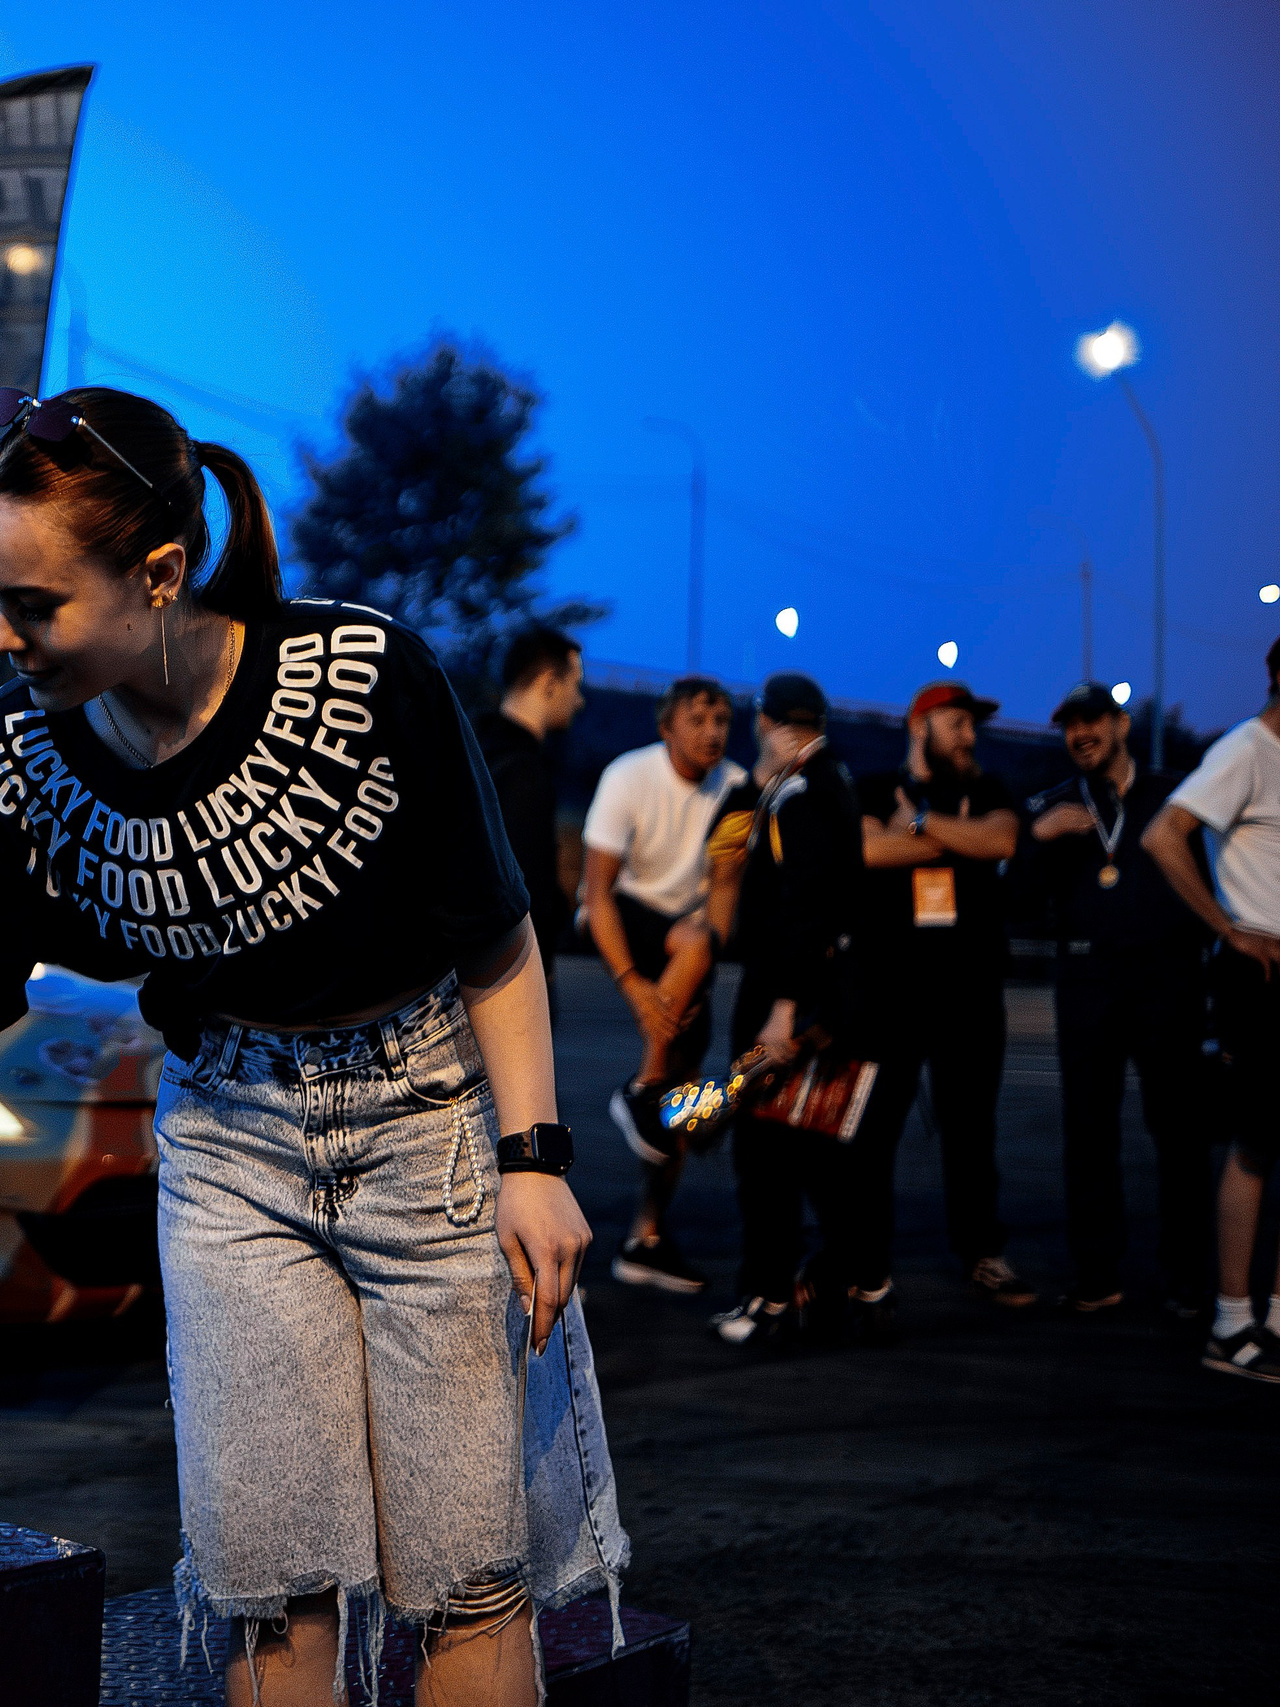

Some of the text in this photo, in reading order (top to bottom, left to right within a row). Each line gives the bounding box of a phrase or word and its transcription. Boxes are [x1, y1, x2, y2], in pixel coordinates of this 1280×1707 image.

[5, 633, 324, 861] LUCKY FOOD LUCKY FOOD
[77, 846, 190, 917] FOOD
[198, 766, 341, 907] LUCKY
[311, 625, 386, 769] FOOD
[120, 918, 221, 960] FOOD
[222, 854, 340, 954] LUCKY
